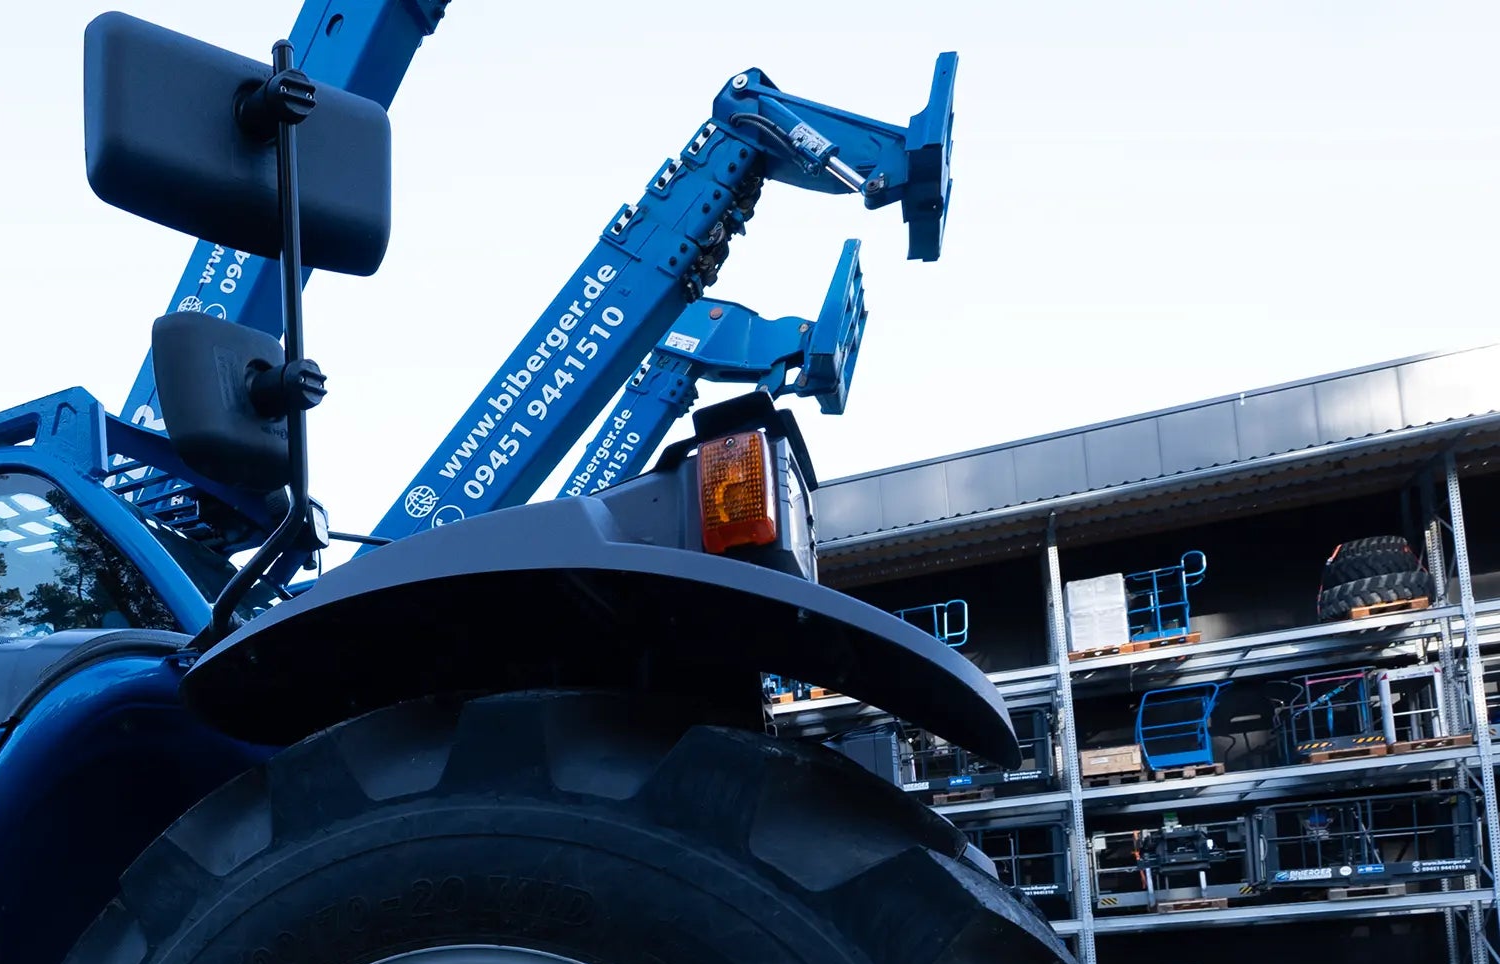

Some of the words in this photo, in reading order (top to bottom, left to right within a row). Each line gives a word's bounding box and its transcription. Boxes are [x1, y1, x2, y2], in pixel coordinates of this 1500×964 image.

[439, 264, 617, 480] www.biberger.de
[463, 421, 532, 499] 09451
[527, 306, 624, 421] 9441510
